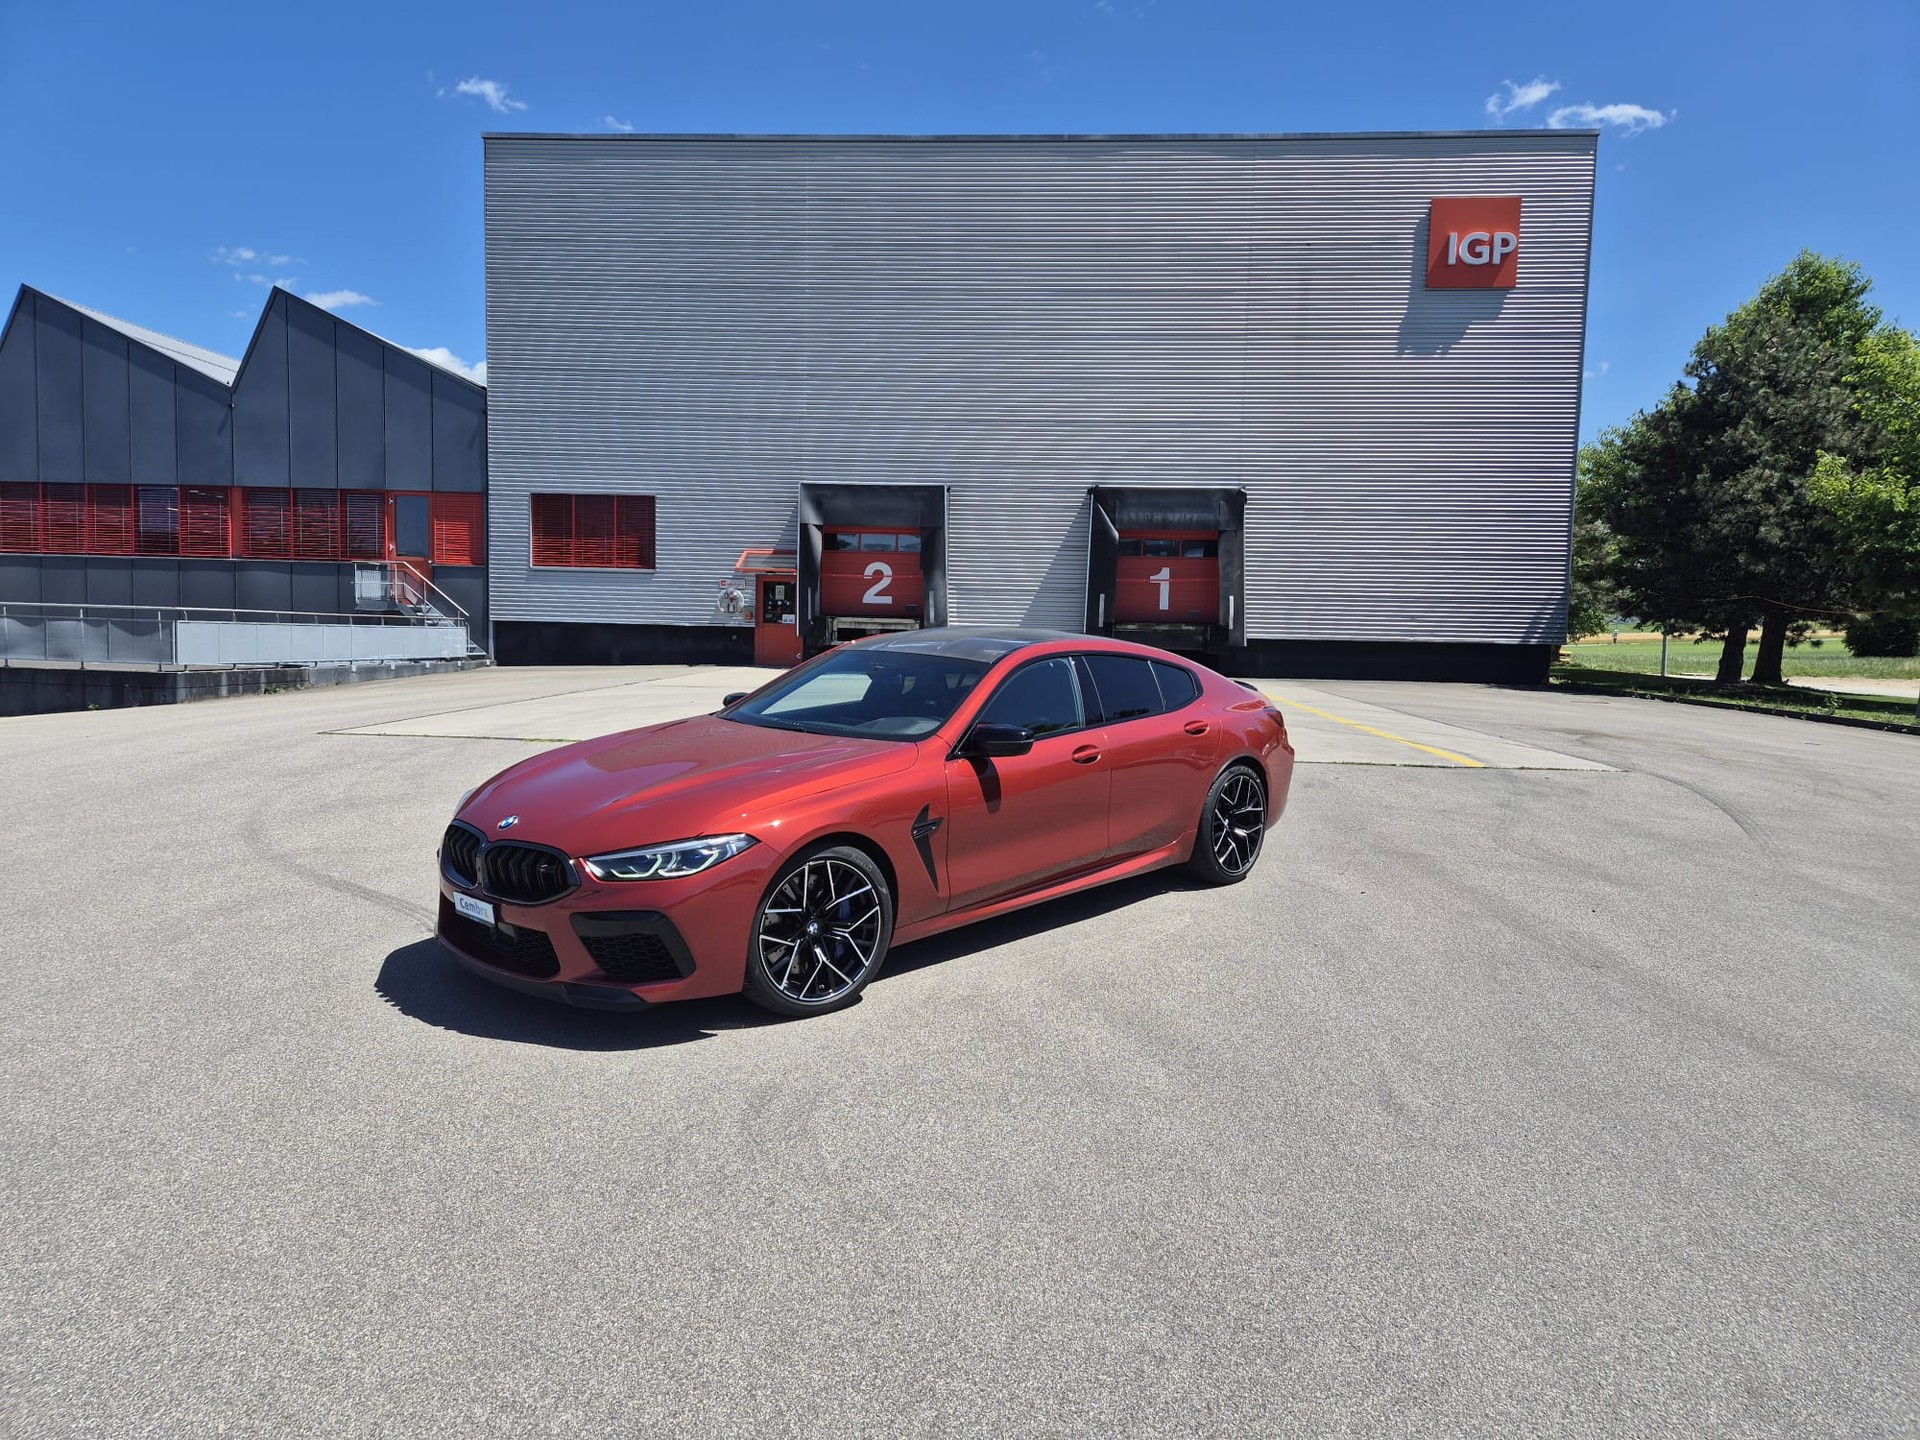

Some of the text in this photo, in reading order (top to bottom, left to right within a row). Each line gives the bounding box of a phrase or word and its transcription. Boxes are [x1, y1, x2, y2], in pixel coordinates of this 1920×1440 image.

[1447, 231, 1518, 265] IGP
[862, 561, 893, 604] 2
[1149, 566, 1170, 610] 1
[459, 897, 490, 918] Cembra
